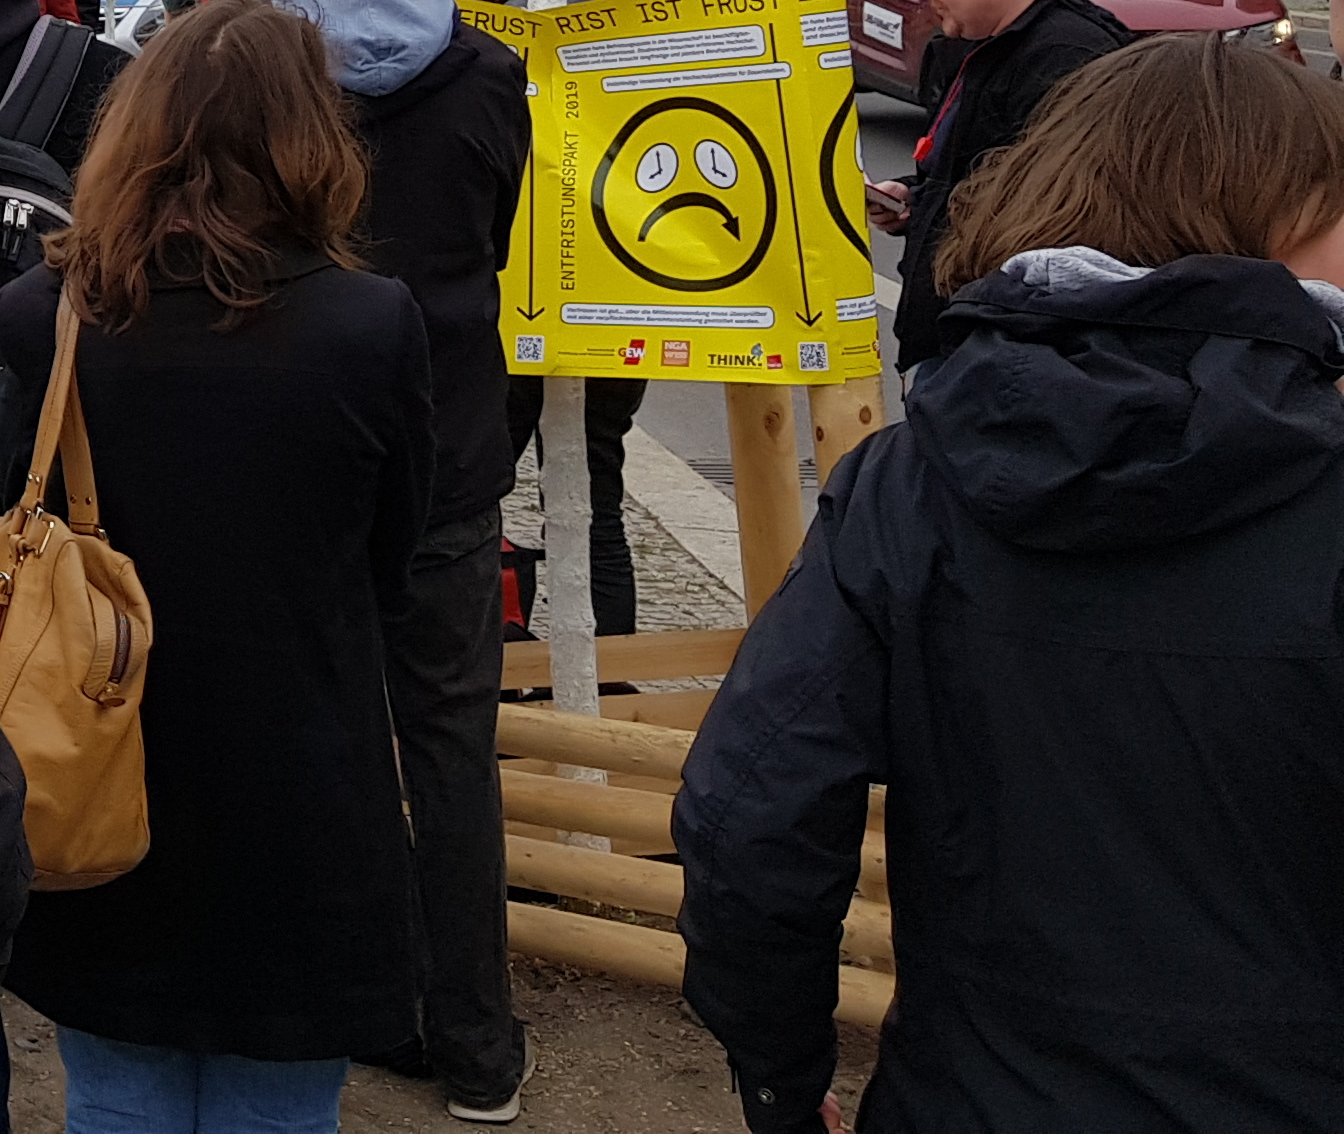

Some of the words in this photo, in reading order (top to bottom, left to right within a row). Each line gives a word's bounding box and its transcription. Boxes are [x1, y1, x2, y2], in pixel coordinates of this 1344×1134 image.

[459, 9, 543, 38] FRUST
[565, 81, 580, 118] 2019
[560, 130, 579, 291] ENTFRISTUNGSPAKT
[618, 348, 646, 358] GEW
